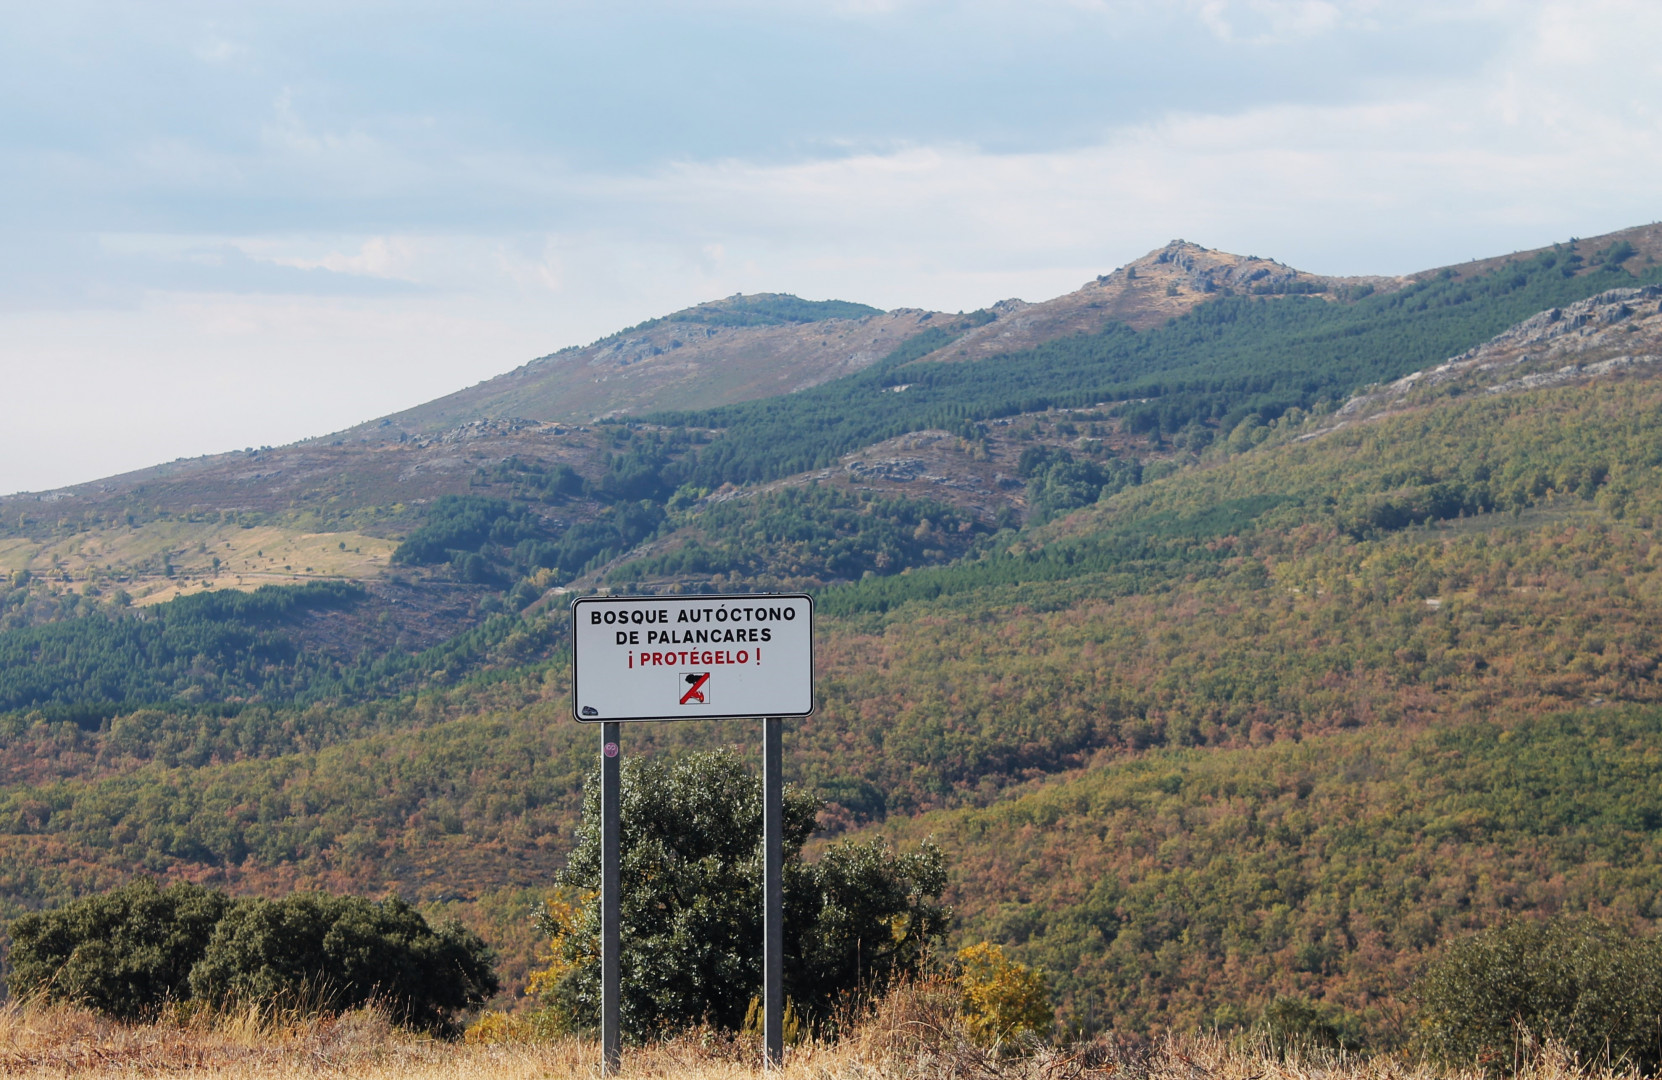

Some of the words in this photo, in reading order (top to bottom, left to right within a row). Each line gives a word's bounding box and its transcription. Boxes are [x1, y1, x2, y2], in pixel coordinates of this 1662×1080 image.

[591, 610, 669, 626] BOSQUE
[677, 604, 796, 624] AUTÓCTONO
[616, 631, 640, 645] DE
[648, 628, 772, 645] PALANCARES
